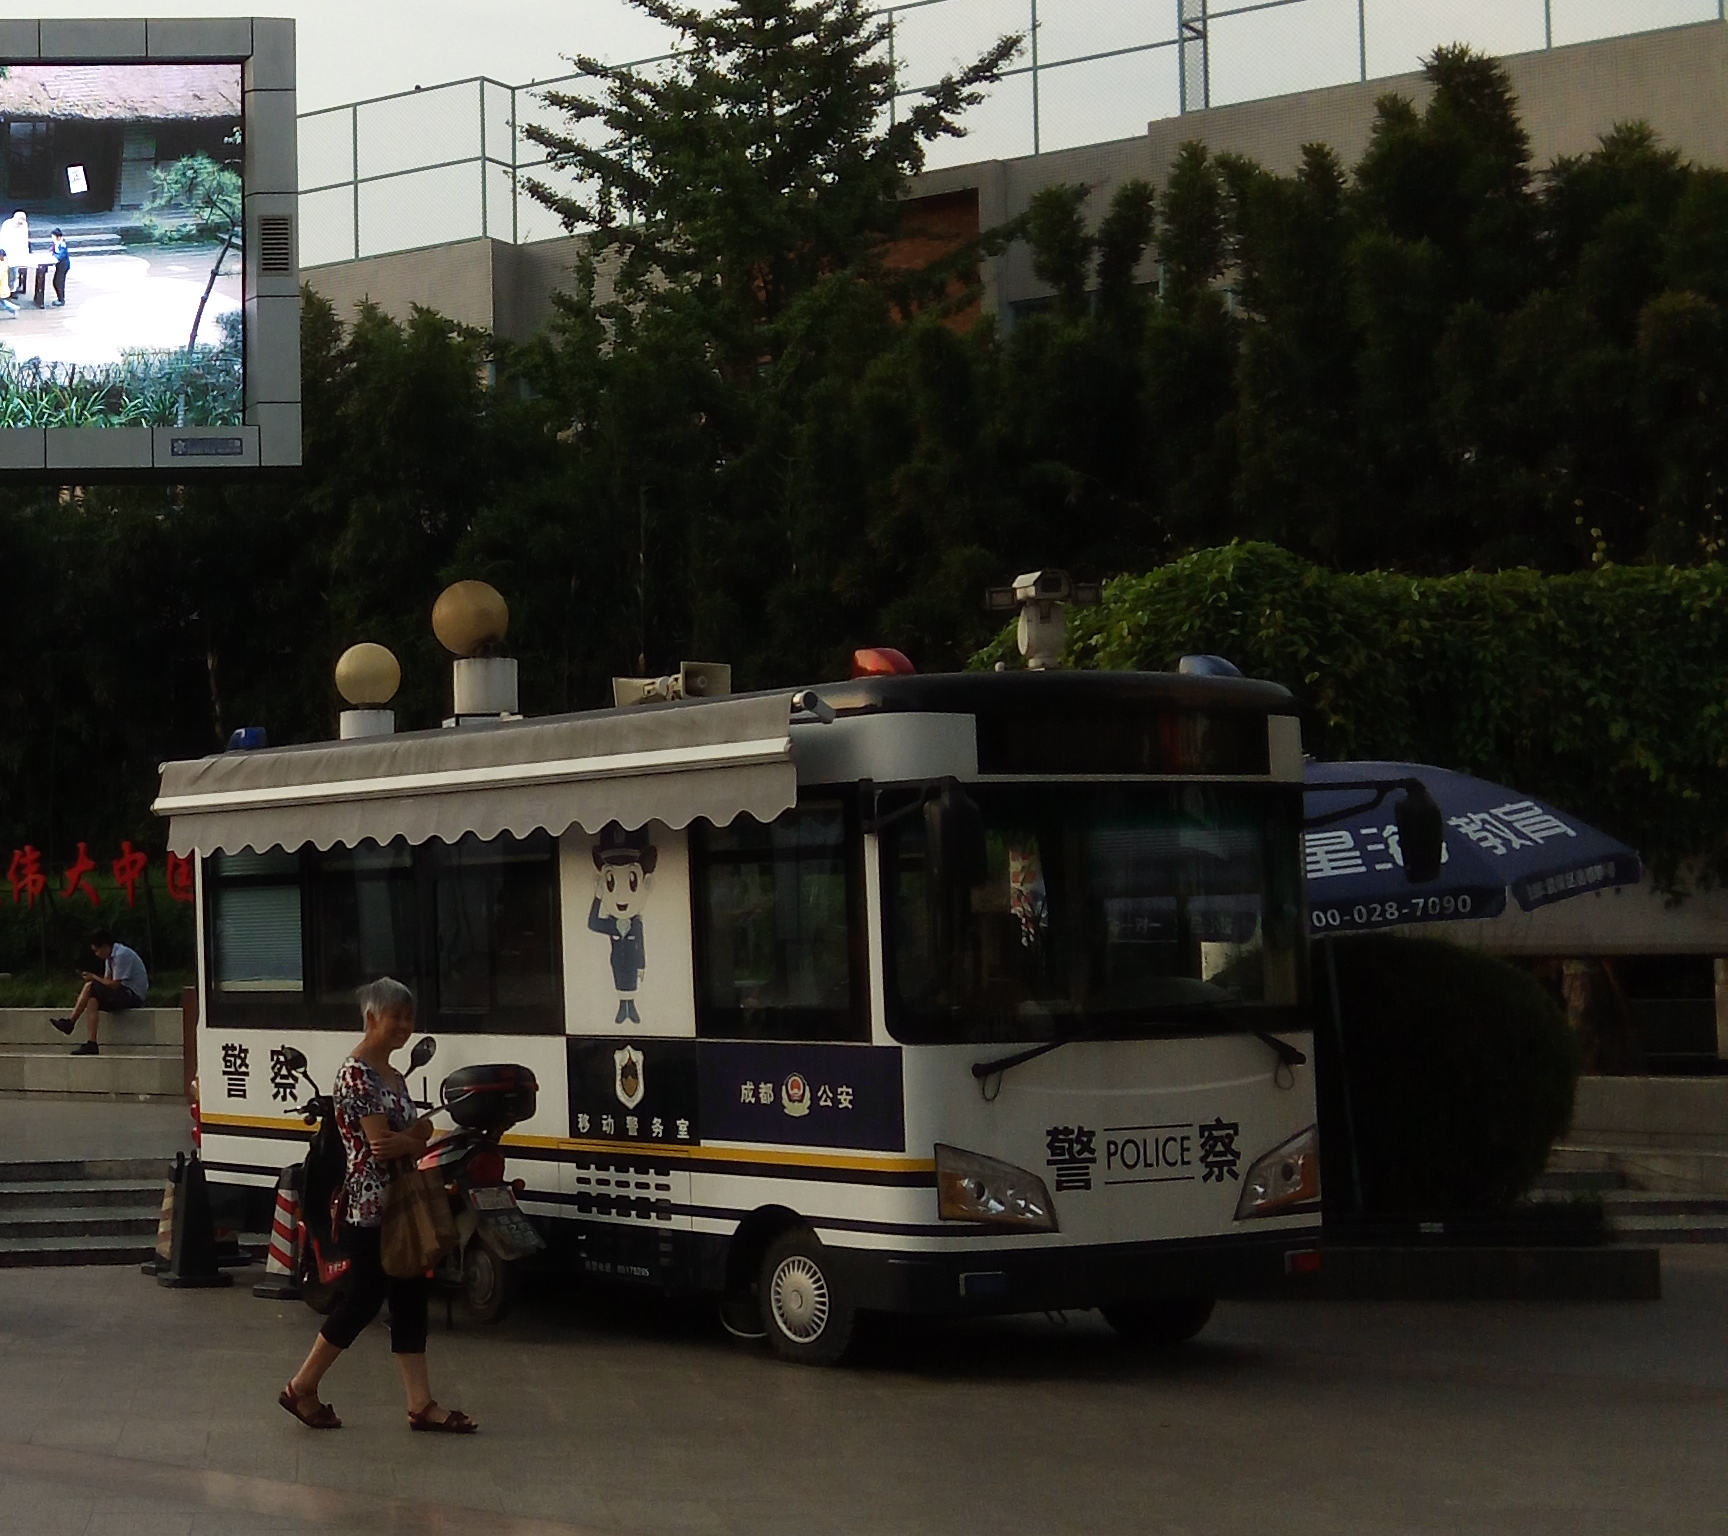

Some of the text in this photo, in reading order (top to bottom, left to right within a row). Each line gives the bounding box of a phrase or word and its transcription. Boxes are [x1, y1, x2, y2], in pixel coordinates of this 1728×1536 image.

[1311, 894, 1473, 928] 00-028-7090
[221, 1042, 299, 1103] 警察
[739, 1080, 855, 1110] 成都 公安
[576, 1112, 691, 1140] 移动警务室
[1045, 1116, 1242, 1192] 警 POLICE 察
